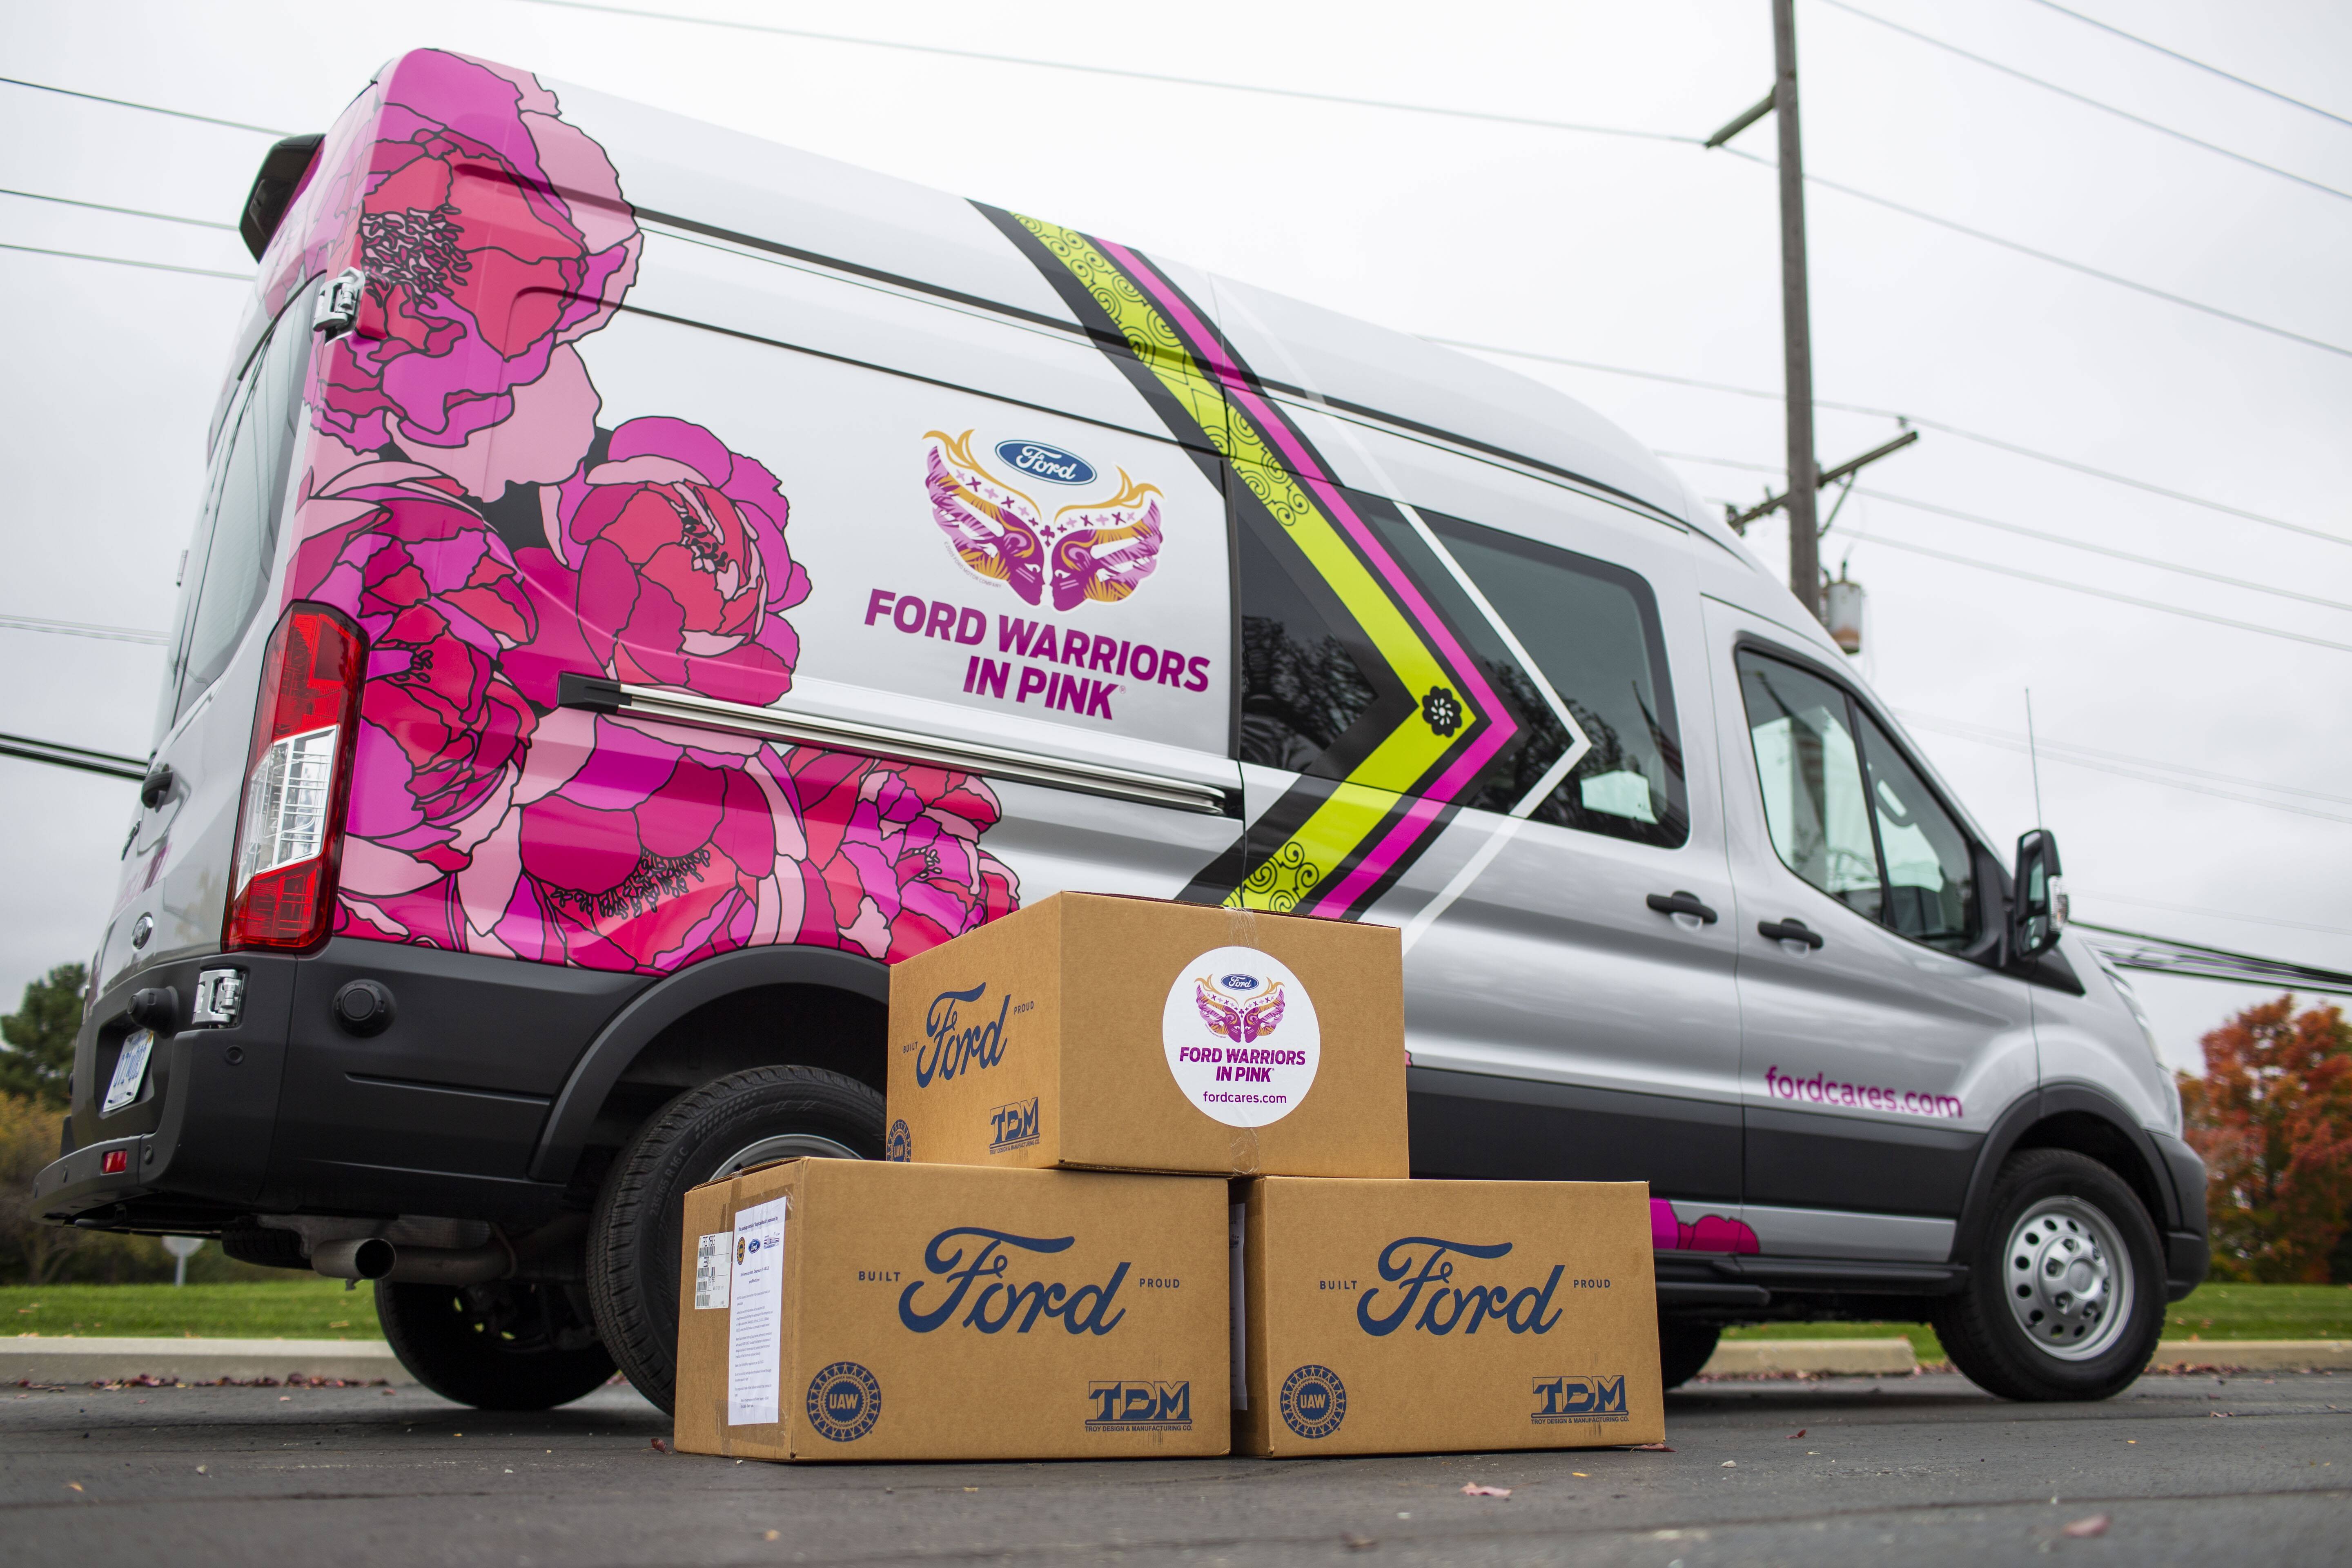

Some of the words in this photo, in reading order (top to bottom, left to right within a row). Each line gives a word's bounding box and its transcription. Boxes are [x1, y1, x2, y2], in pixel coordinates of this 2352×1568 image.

[1016, 445, 1077, 480] Ford
[963, 568, 979, 580] MOTOR
[865, 589, 986, 646] FORD
[999, 615, 1209, 692] WARRIORS
[963, 655, 1011, 699] IN
[1229, 976, 1252, 988] Ford
[903, 1041, 918, 1054] BUILT
[916, 982, 1011, 1089] Ford
[1013, 1001, 1034, 1016] PROUD
[1179, 1047, 1223, 1062] FORD
[1225, 1048, 1306, 1065] WARRIORS
[1216, 1066, 1232, 1082] IN
[1203, 1091, 1287, 1103] fordcares.com
[1766, 1066, 1962, 1118] fordcares.com
[990, 1096, 1038, 1144] TDM
[1011, 1140, 1035, 1150] MANUFACTURING
[649, 1178, 669, 1216] 235/65
[665, 1168, 675, 1178] R
[670, 1155, 682, 1167] 16
[679, 1147, 688, 1156] C
[859, 1271, 900, 1282] BUILT
[898, 1227, 1131, 1336] Ford
[1139, 1278, 1180, 1288] PROUD
[1319, 1280, 1358, 1290] BUILT
[1357, 1236, 1566, 1336] Ford
[1573, 1279, 1611, 1288] PROUD
[829, 1393, 859, 1409] UAW
[1089, 1381, 1189, 1421] TDM
[1300, 1394, 1326, 1409] UAW
[1532, 1375, 1626, 1414] TDM
